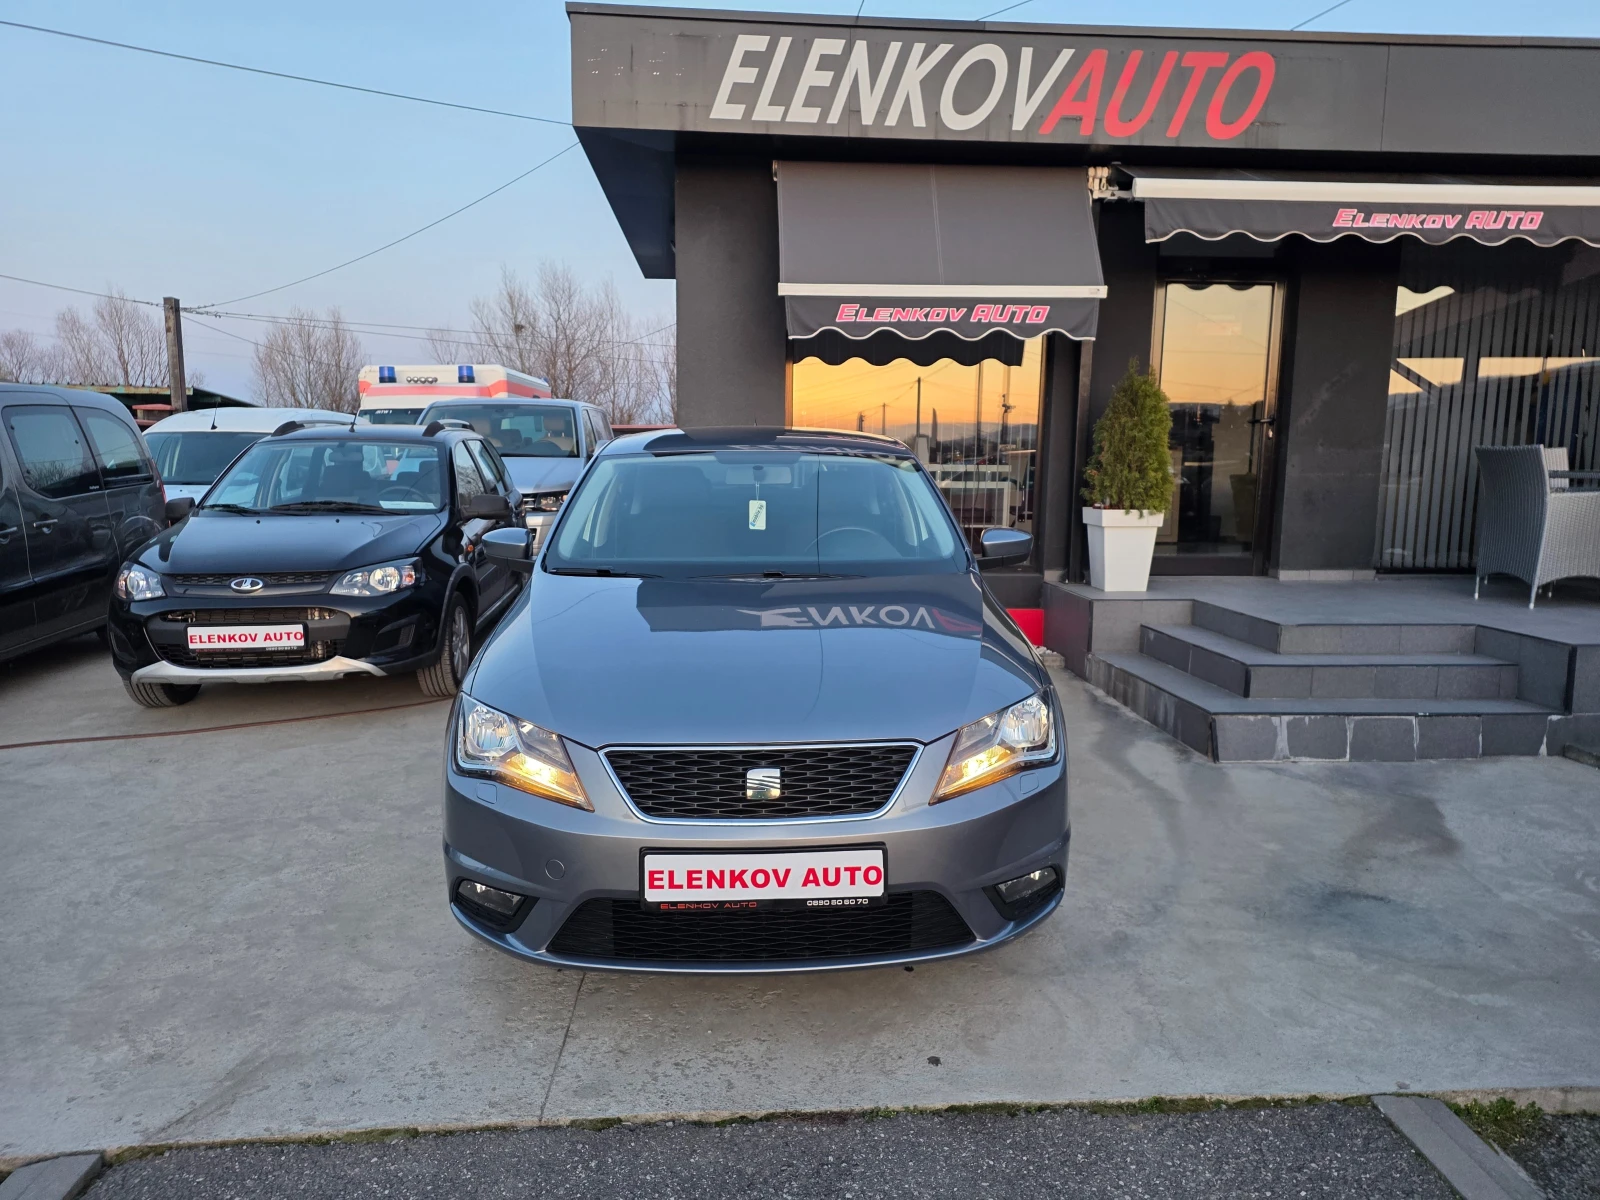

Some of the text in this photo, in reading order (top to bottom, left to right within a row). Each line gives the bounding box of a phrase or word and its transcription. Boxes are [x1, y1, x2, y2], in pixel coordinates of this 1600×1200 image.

[1332, 208, 1544, 230] ELENKOV AUTO
[835, 303, 1050, 323] ELENKOV AUTO
[189, 631, 304, 643] ELENKOV AUTO
[648, 865, 883, 890] ELENKOV AUTO
[723, 901, 758, 909] AUTO
